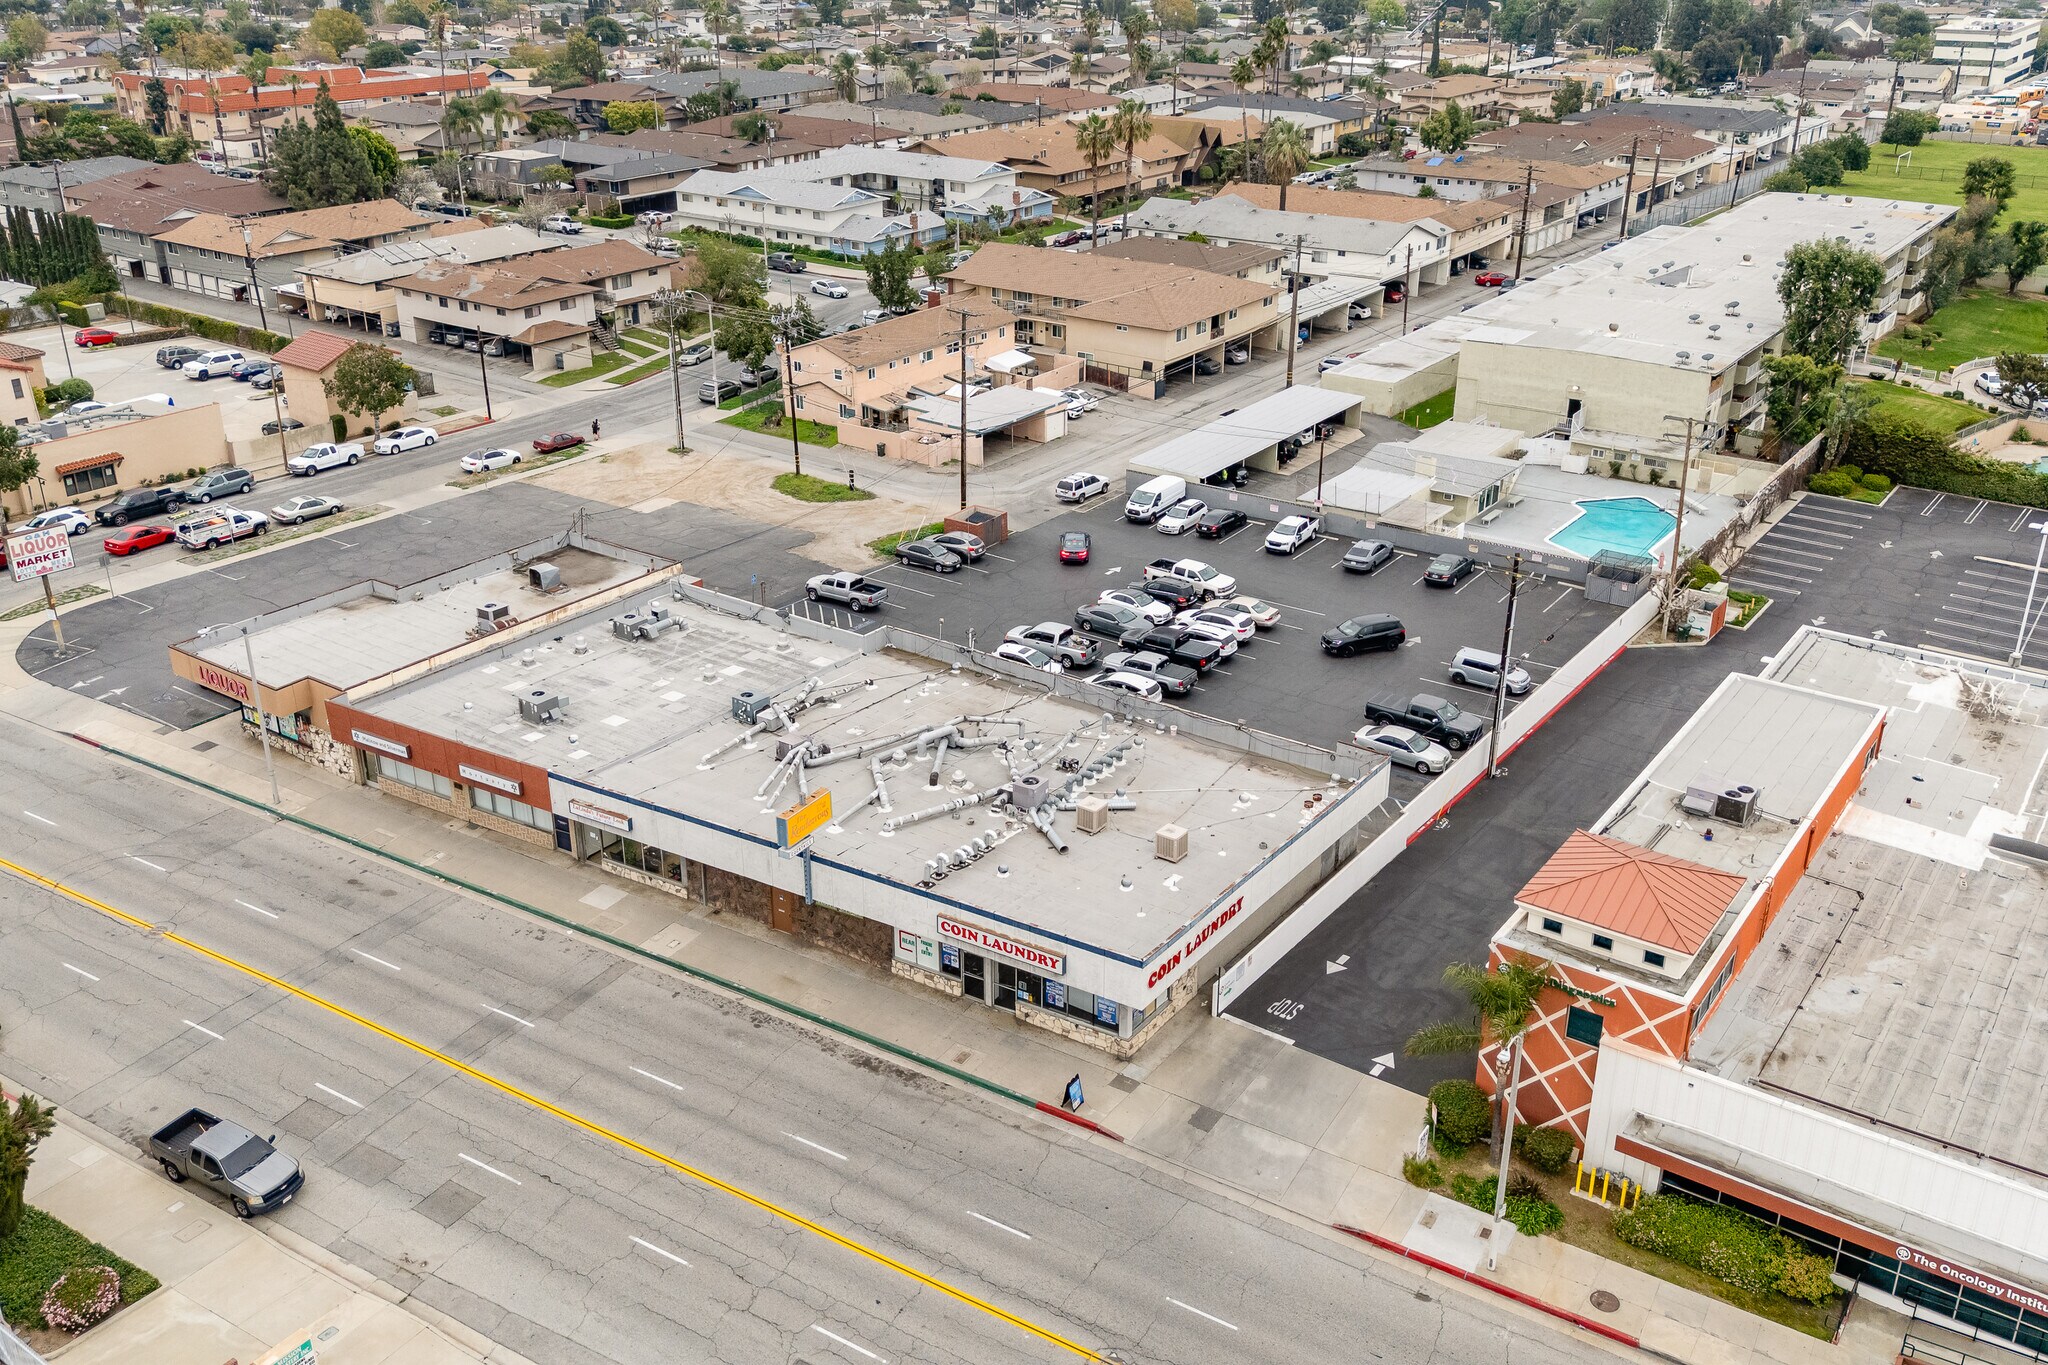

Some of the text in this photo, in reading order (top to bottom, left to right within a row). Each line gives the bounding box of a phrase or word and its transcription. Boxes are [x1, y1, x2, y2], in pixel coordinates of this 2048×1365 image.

[11, 533, 67, 558] LIQUOR
[16, 549, 67, 568] MARKET
[199, 665, 249, 700] LIQUOR
[940, 921, 978, 942] COIN
[982, 935, 1059, 969] LAUNDRY
[1148, 895, 1244, 988] COIN LAUNDRY
[1549, 976, 1617, 1008] Diagnostics
[1267, 998, 1304, 1020] STOP
[1913, 1252, 1937, 1270] The
[1939, 1264, 2004, 1295] Oncology
